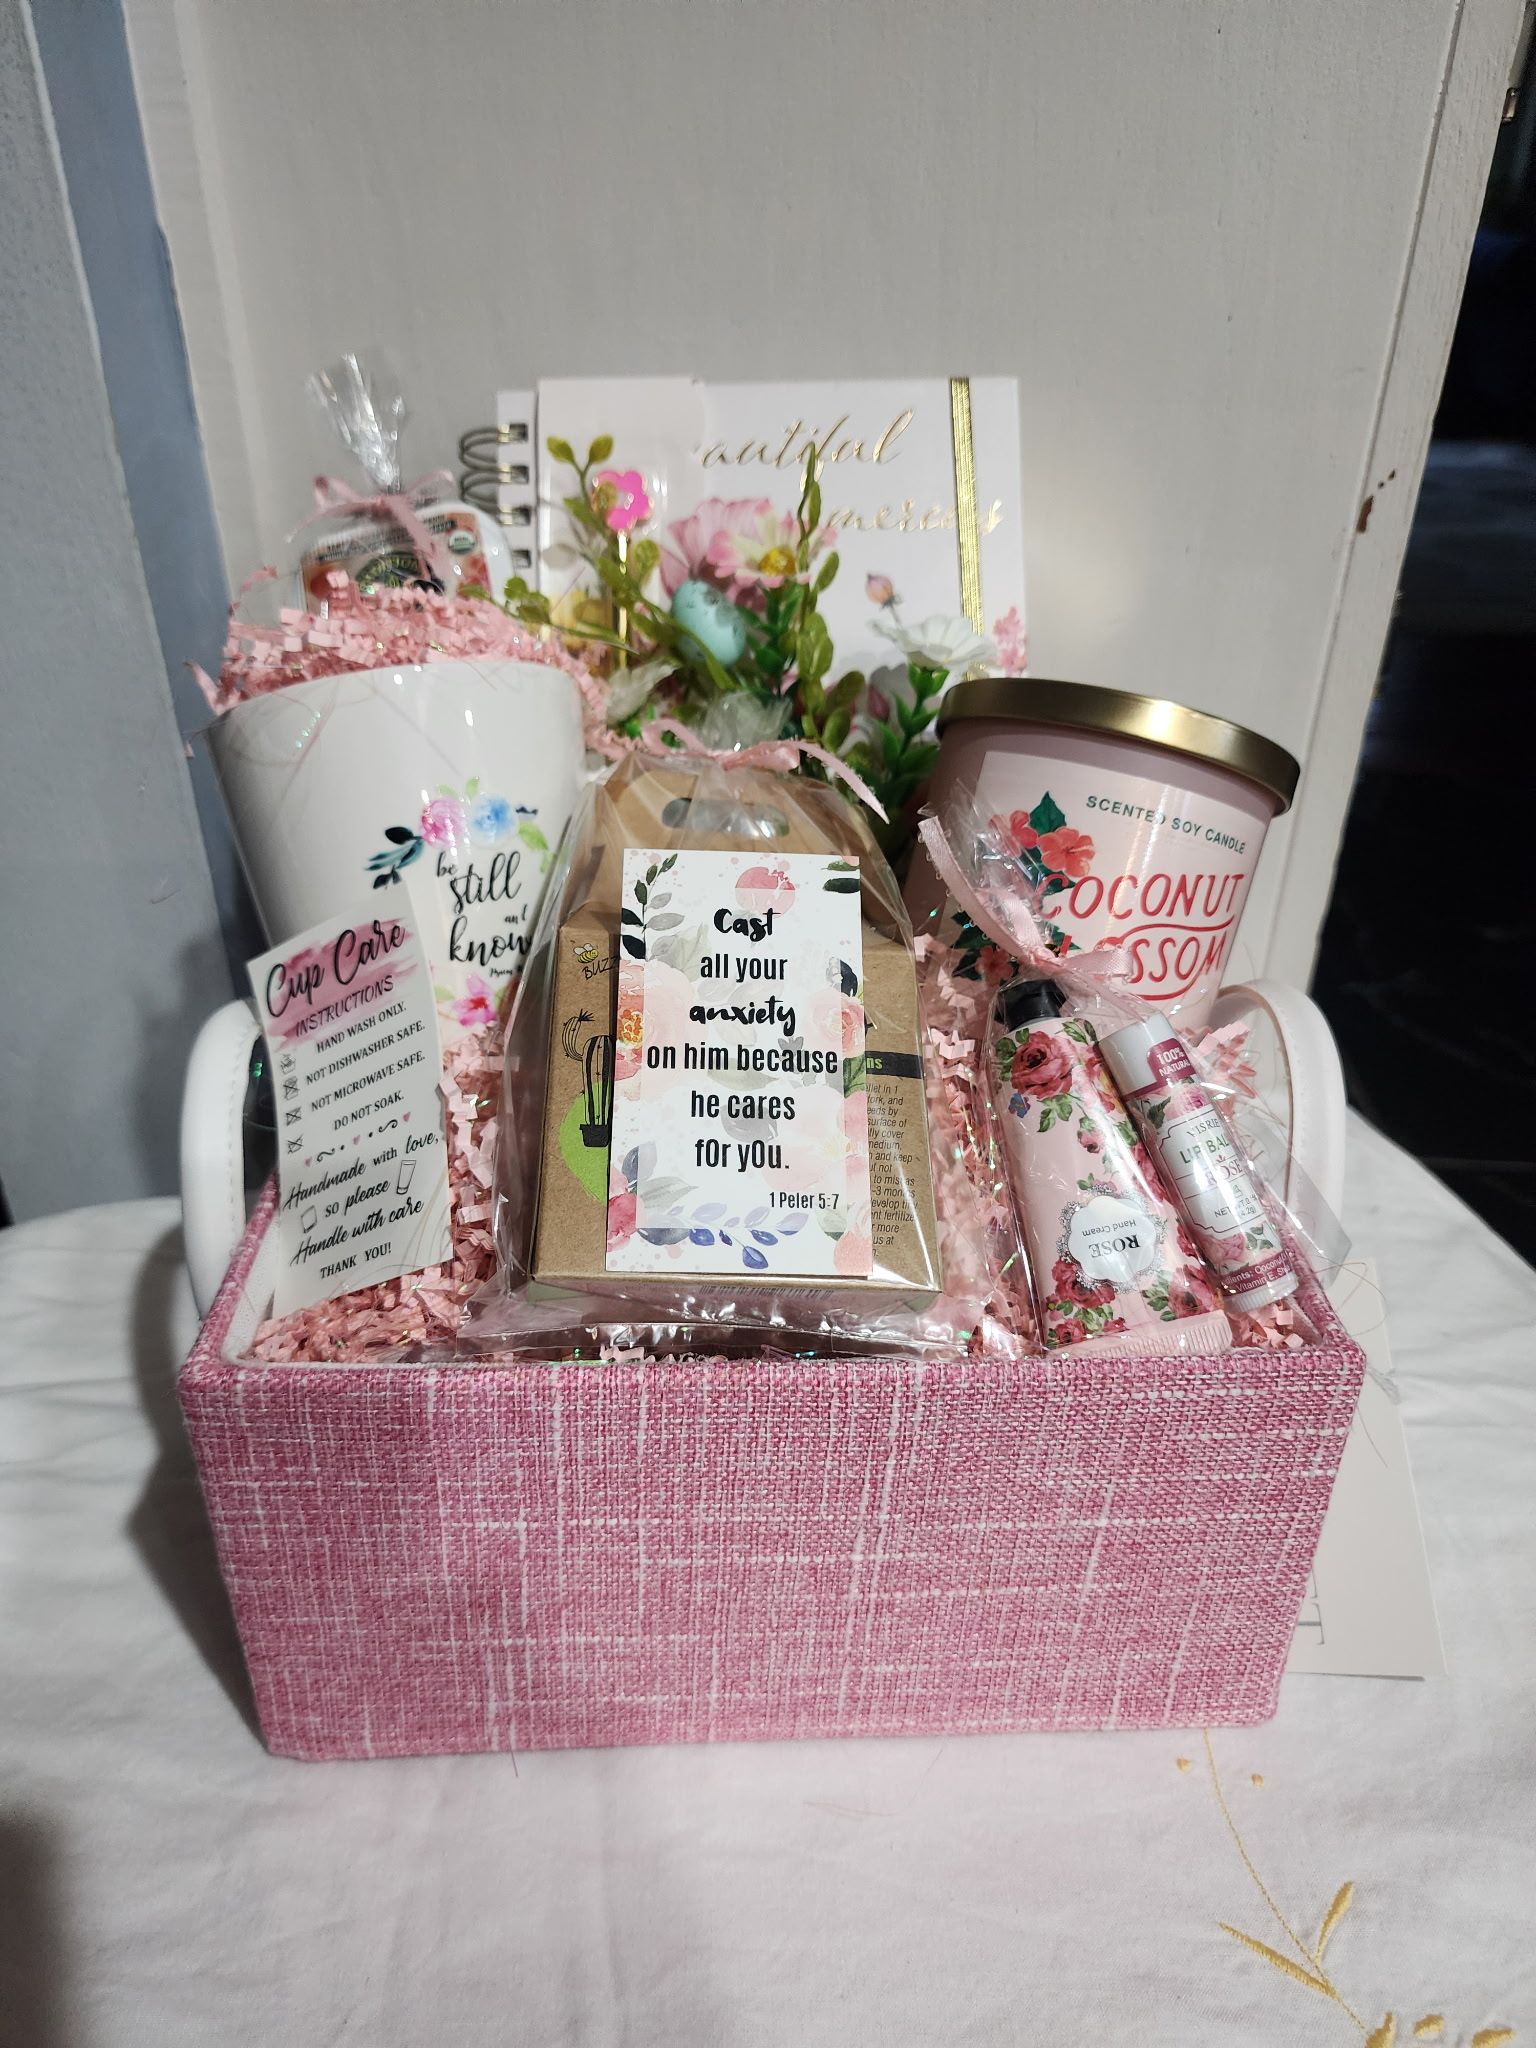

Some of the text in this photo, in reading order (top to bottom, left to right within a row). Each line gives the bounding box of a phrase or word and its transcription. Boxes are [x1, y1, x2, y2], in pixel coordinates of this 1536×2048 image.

[701, 409, 912, 492] autiful
[1086, 795, 1246, 855] SCENTED SOY CANDLE
[437, 851, 458, 877] be
[450, 851, 521, 914] still
[1036, 873, 1244, 920] COCONUT
[714, 908, 781, 942] Cast
[450, 915, 532, 966] know
[266, 919, 406, 1018] Cup Care
[700, 953, 788, 983] all your
[1129, 931, 1228, 984] SSOM
[295, 975, 394, 1037] INSTRUCTIONS
[689, 995, 796, 1036] anxiety
[316, 1001, 407, 1053] HAND WASH ONLY.
[306, 1020, 425, 1085] NOT DISHWASHER SAFE.
[647, 1042, 838, 1074] on him because
[1156, 1047, 1184, 1065] 100%
[311, 1050, 425, 1112] NOT MICROWAVE SAFE.
[1159, 1059, 1191, 1077] NATURAL
[884, 1085, 891, 1094] in
[888, 1097, 903, 1105] and
[334, 1090, 405, 1131] DO NOT SOAK.
[691, 1090, 796, 1120] he cares
[867, 1107, 898, 1117] eeds by
[867, 1118, 907, 1128] surface of
[881, 1130, 905, 1138] cover
[875, 1152, 891, 1161] and
[893, 1152, 912, 1165] keep
[1180, 1134, 1230, 1164] LIP BAL
[282, 1131, 439, 1211] Handmade with love,
[874, 1174, 882, 1184] to
[884, 1175, 901, 1185] mis
[879, 1164, 892, 1172] not
[344, 1179, 390, 1216] please
[769, 1192, 775, 1208] 1
[818, 1193, 839, 1209] 5:7
[883, 1188, 916, 1198] mons
[290, 1196, 424, 1267] Handle with care
[877, 1224, 900, 1233] more
[884, 1211, 915, 1222] fertilize
[1082, 1219, 1137, 1237] Hand Cream
[886, 1236, 894, 1245] at
[1089, 1234, 1140, 1258] ROSE
[320, 1242, 392, 1279] THANK YOU!
